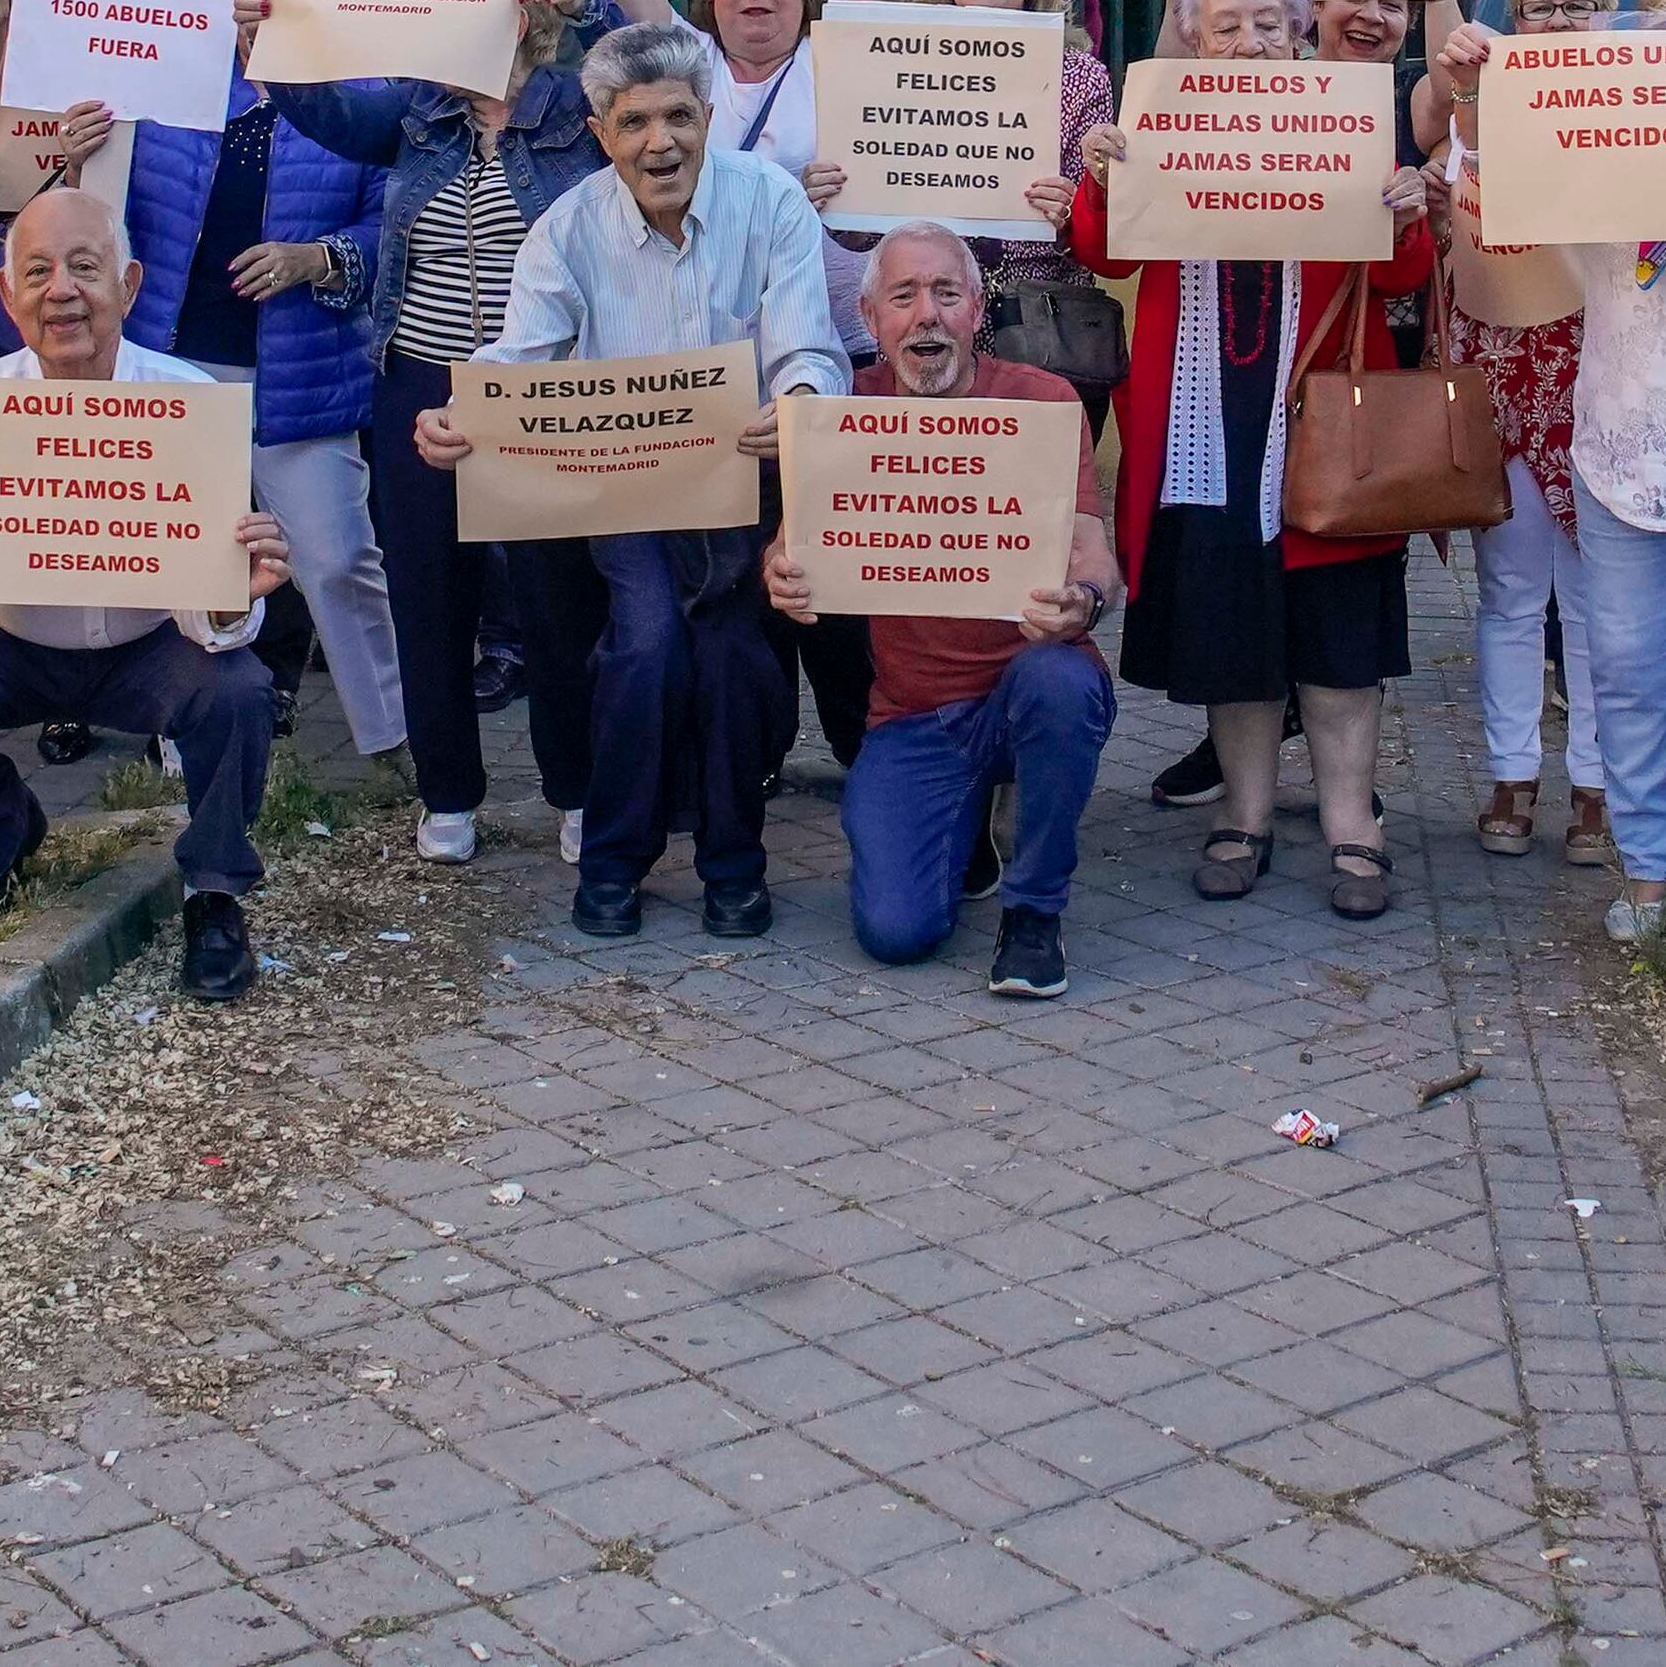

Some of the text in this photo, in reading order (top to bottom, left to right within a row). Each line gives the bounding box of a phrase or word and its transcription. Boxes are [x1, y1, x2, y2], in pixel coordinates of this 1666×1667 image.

[105, 5, 208, 30] ABUELOS
[89, 37, 158, 60] FUERA
[870, 34, 1025, 58] AQUÍ SOMOS
[1505, 47, 1633, 70] ABUELOS
[897, 73, 996, 92] FELICES
[1180, 75, 1332, 94] ABUELOS Y
[1529, 88, 1622, 109] JAMAS
[863, 107, 1027, 129] EVITAMOS LA
[1136, 113, 1374, 133] ABUELAS UNIDOS
[853, 141, 1034, 160] SOLEDAD QUE NO
[1159, 153, 1350, 172] JAMAS SERAN
[887, 172, 999, 189] DESEAMOS
[1186, 192, 1324, 210] VENCIDOS
[485, 367, 726, 398] D. JESUS NUÑEZ
[519, 408, 693, 433] VELAZQUEZ
[839, 411, 1018, 435] AQUÍ SOMOS
[500, 437, 714, 457] PRESIDENTE DE LA FUNDACION
[557, 460, 659, 473] MONTEMADRID
[871, 455, 985, 474] FELICES
[833, 494, 1022, 515] EVITAMOS LA
[822, 531, 1030, 550] SOLEDAD QUE NO
[862, 566, 989, 582] DESEAMOS
